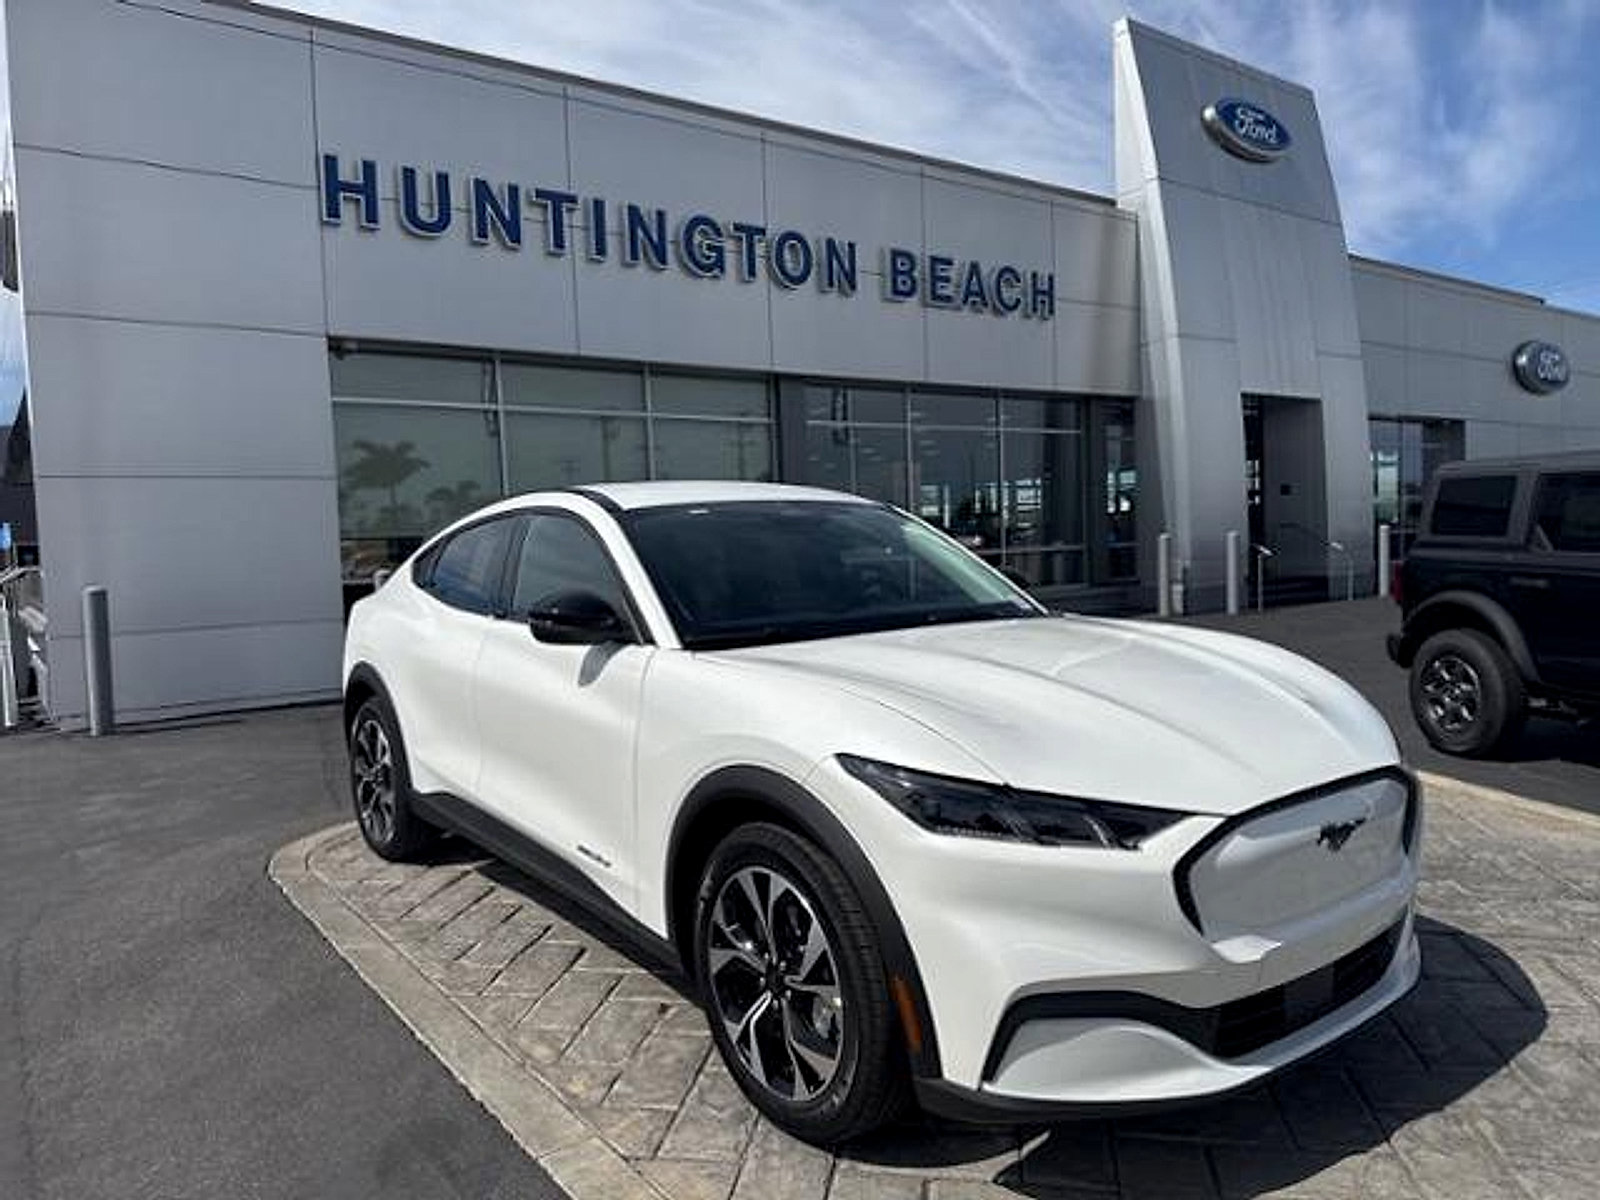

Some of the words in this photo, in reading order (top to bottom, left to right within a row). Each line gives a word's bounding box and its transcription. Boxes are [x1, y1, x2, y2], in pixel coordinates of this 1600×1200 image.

[1233, 107, 1277, 144] Ford
[320, 152, 859, 297] HUNTINGTON
[882, 248, 1056, 320] BEACH
